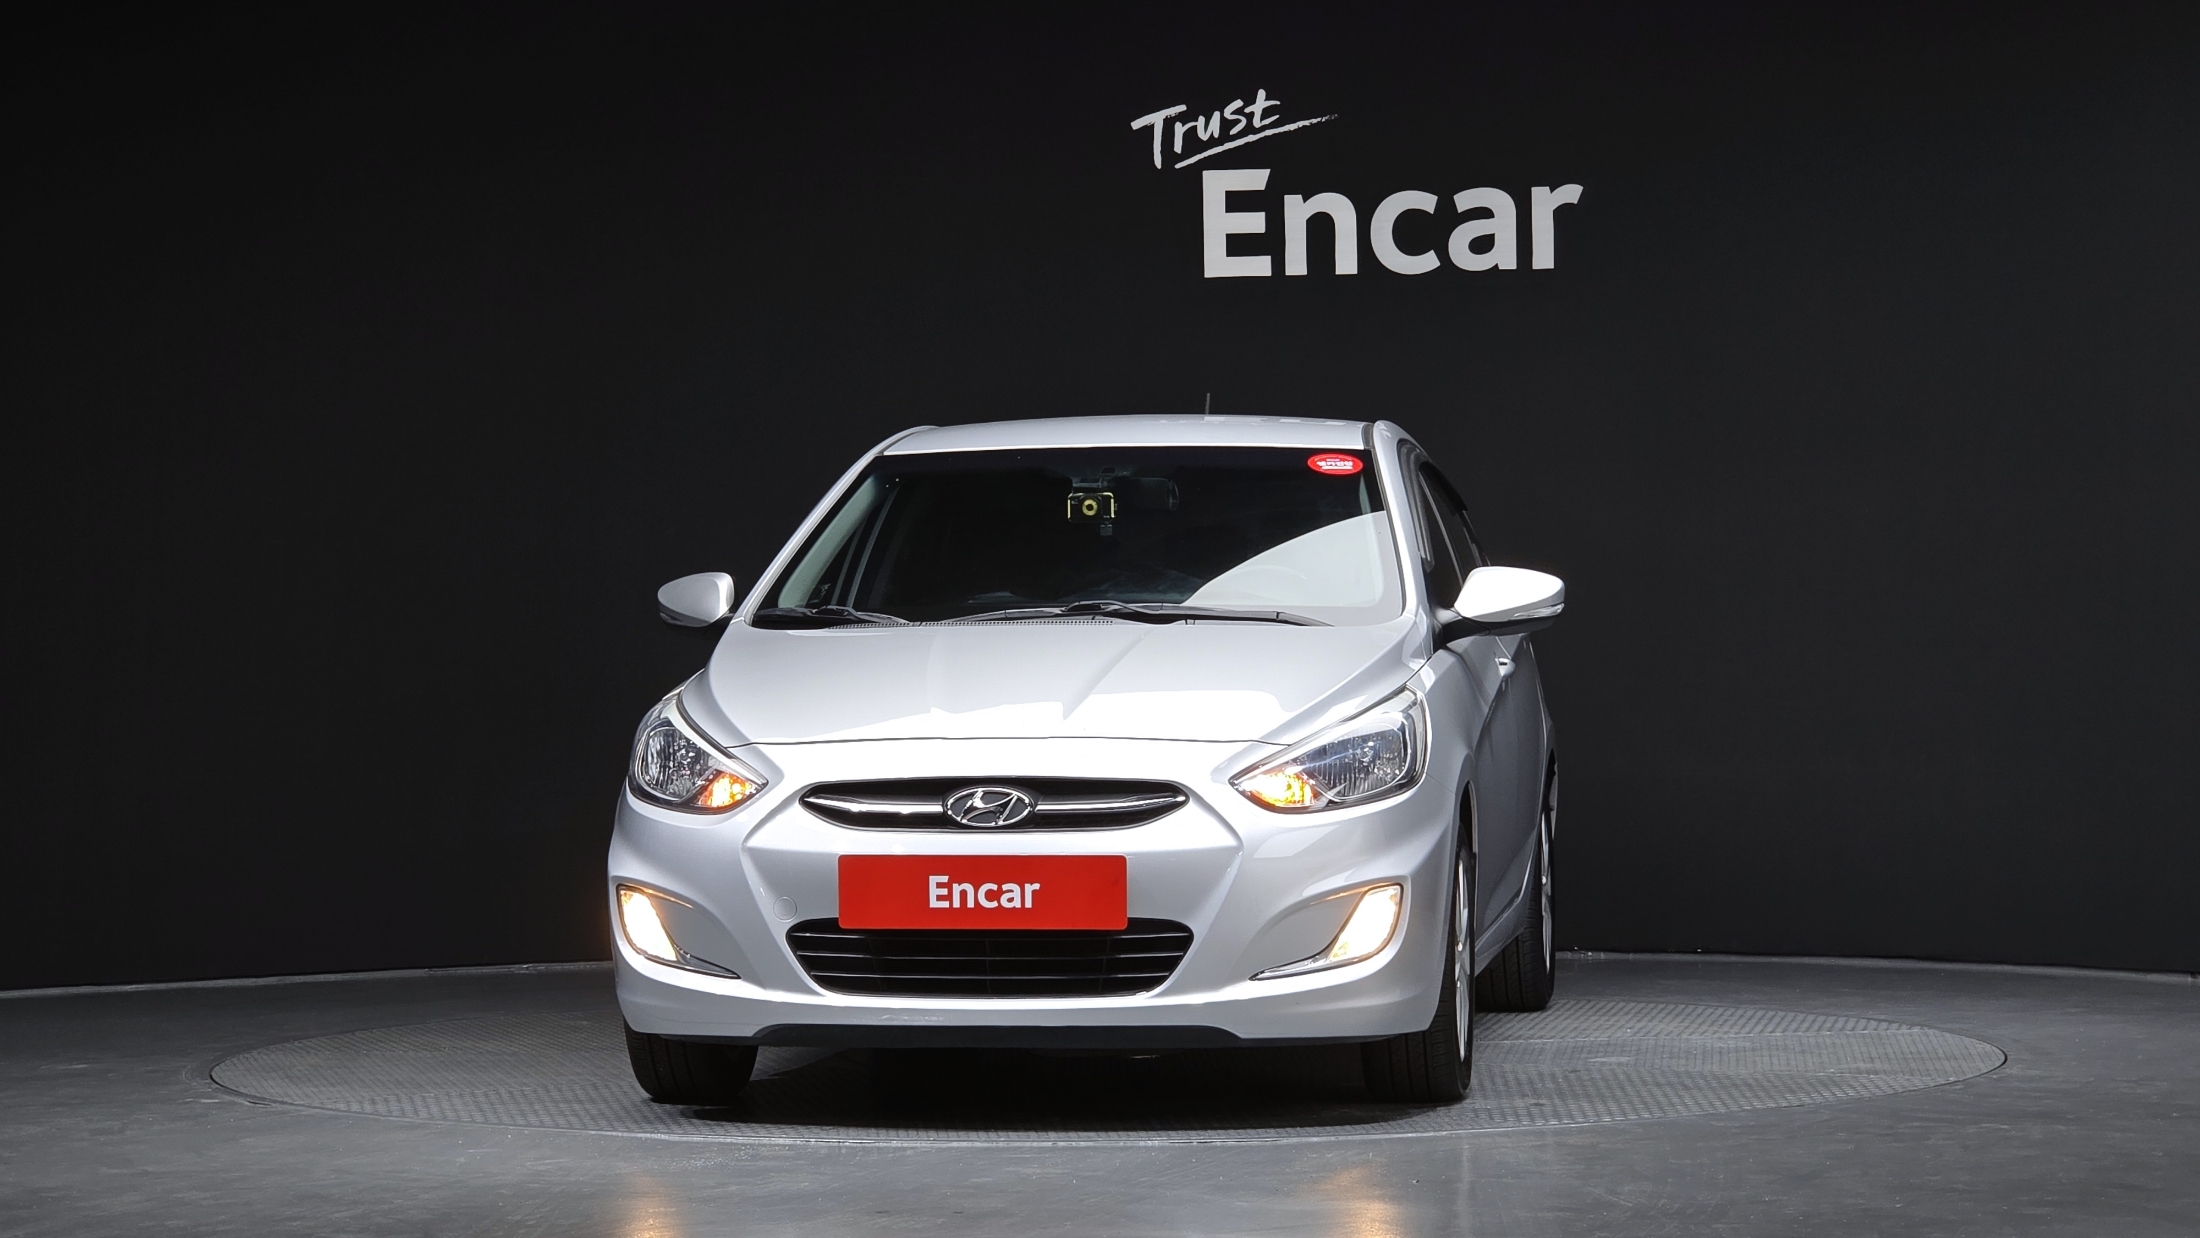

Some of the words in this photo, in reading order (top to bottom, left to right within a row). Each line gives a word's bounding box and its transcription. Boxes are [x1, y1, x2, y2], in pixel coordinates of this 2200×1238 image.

[1131, 88, 1282, 170] Trust
[1202, 168, 1584, 279] Encar
[928, 875, 1041, 909] Encar
